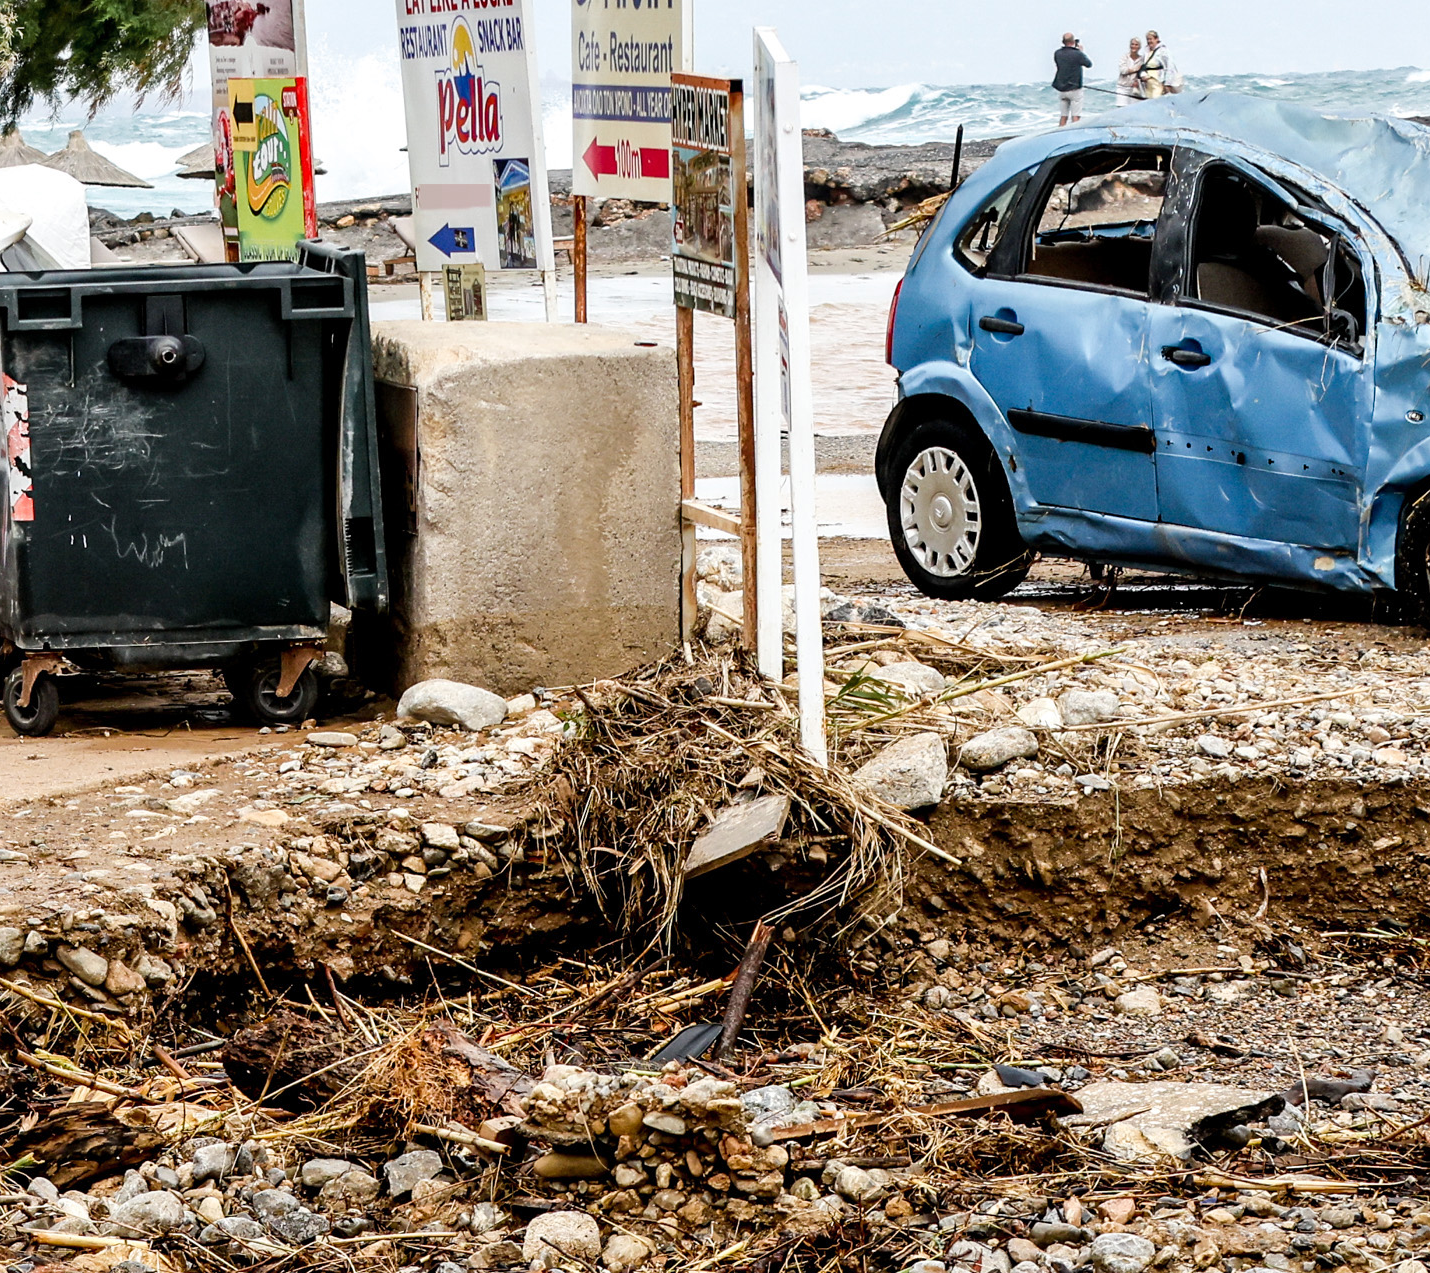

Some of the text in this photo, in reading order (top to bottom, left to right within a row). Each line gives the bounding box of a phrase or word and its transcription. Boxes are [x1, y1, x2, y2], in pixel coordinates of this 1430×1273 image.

[400, 24, 447, 59] RESTAURANT
[478, 17, 524, 53] SNACK BAR
[578, 30, 600, 72] Cafe
[610, 31, 673, 74] Restaurant
[672, 83, 729, 153] HYPER MARKET
[617, 139, 641, 179] 100m
